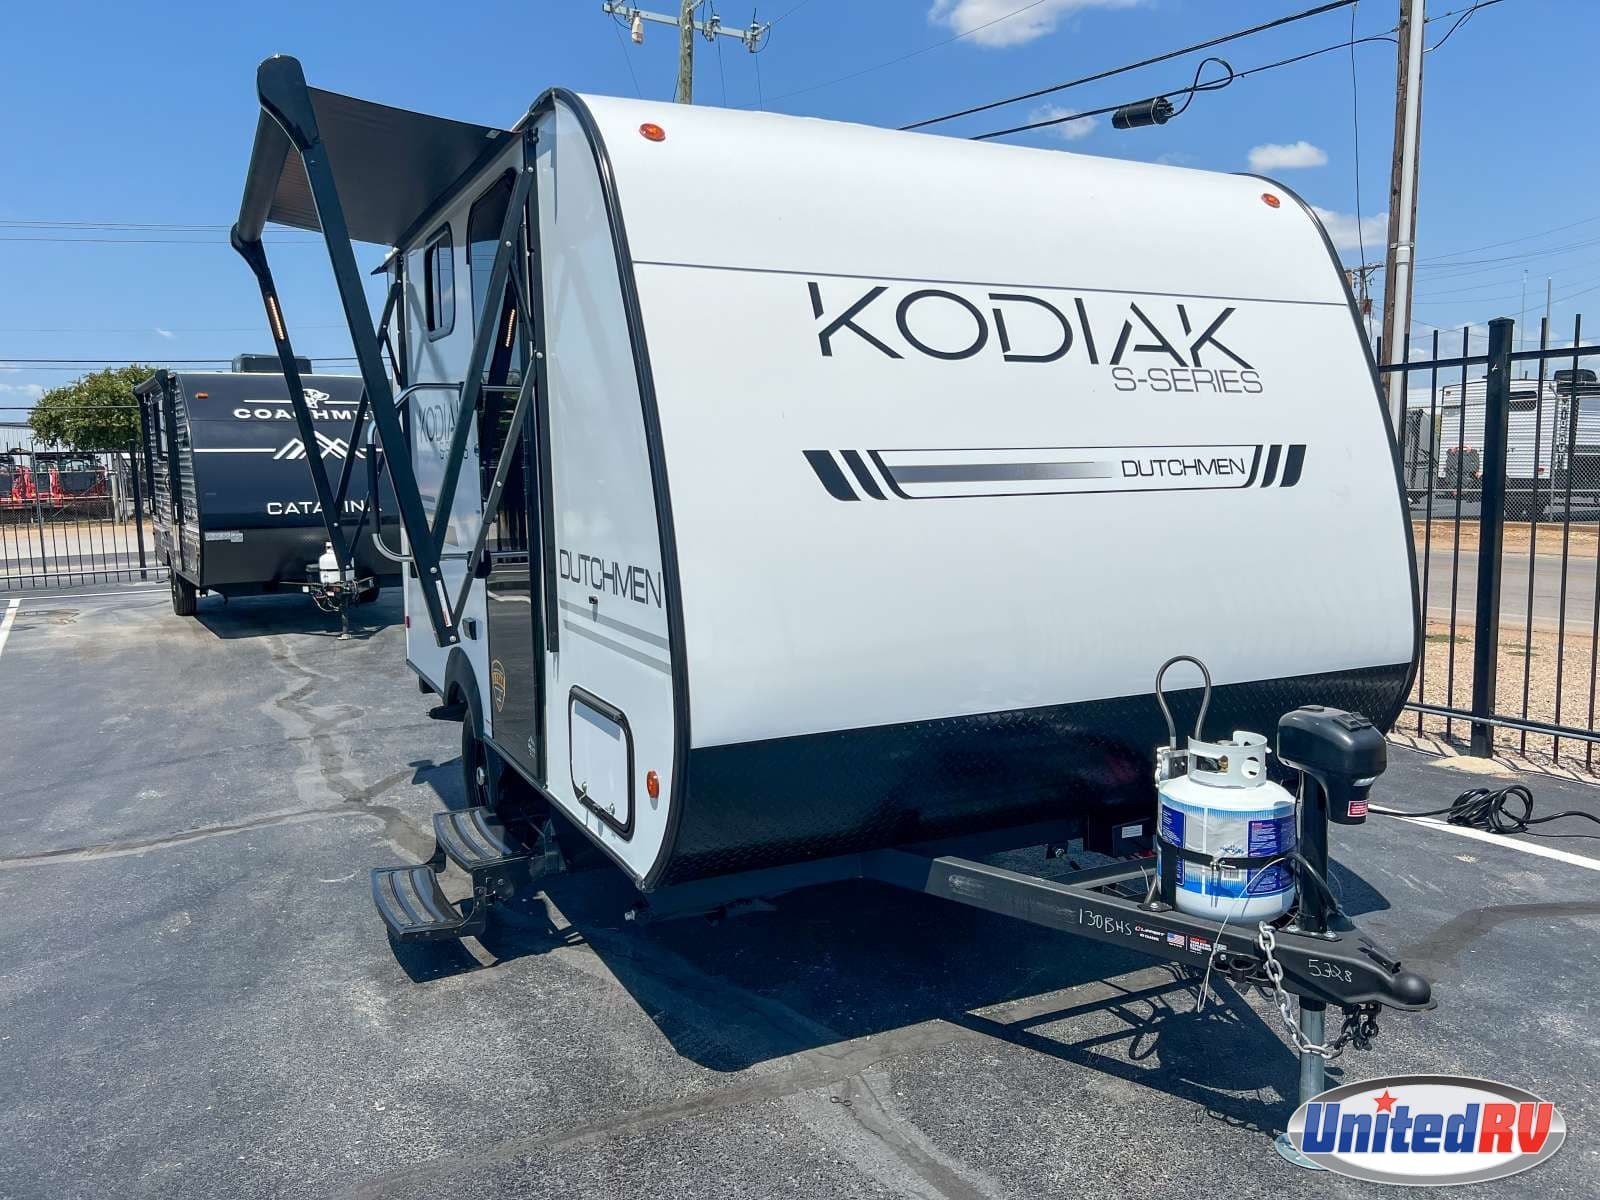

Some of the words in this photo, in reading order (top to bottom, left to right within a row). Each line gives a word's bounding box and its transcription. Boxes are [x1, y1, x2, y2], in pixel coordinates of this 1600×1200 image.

[807, 281, 1255, 369] KODIAK
[1111, 367, 1263, 393] S-SERIES
[418, 400, 459, 443] KODIA
[1121, 458, 1246, 477] DUTCHMEN
[559, 548, 662, 609] DUTCHMEN
[1079, 908, 1132, 936] 130BHS
